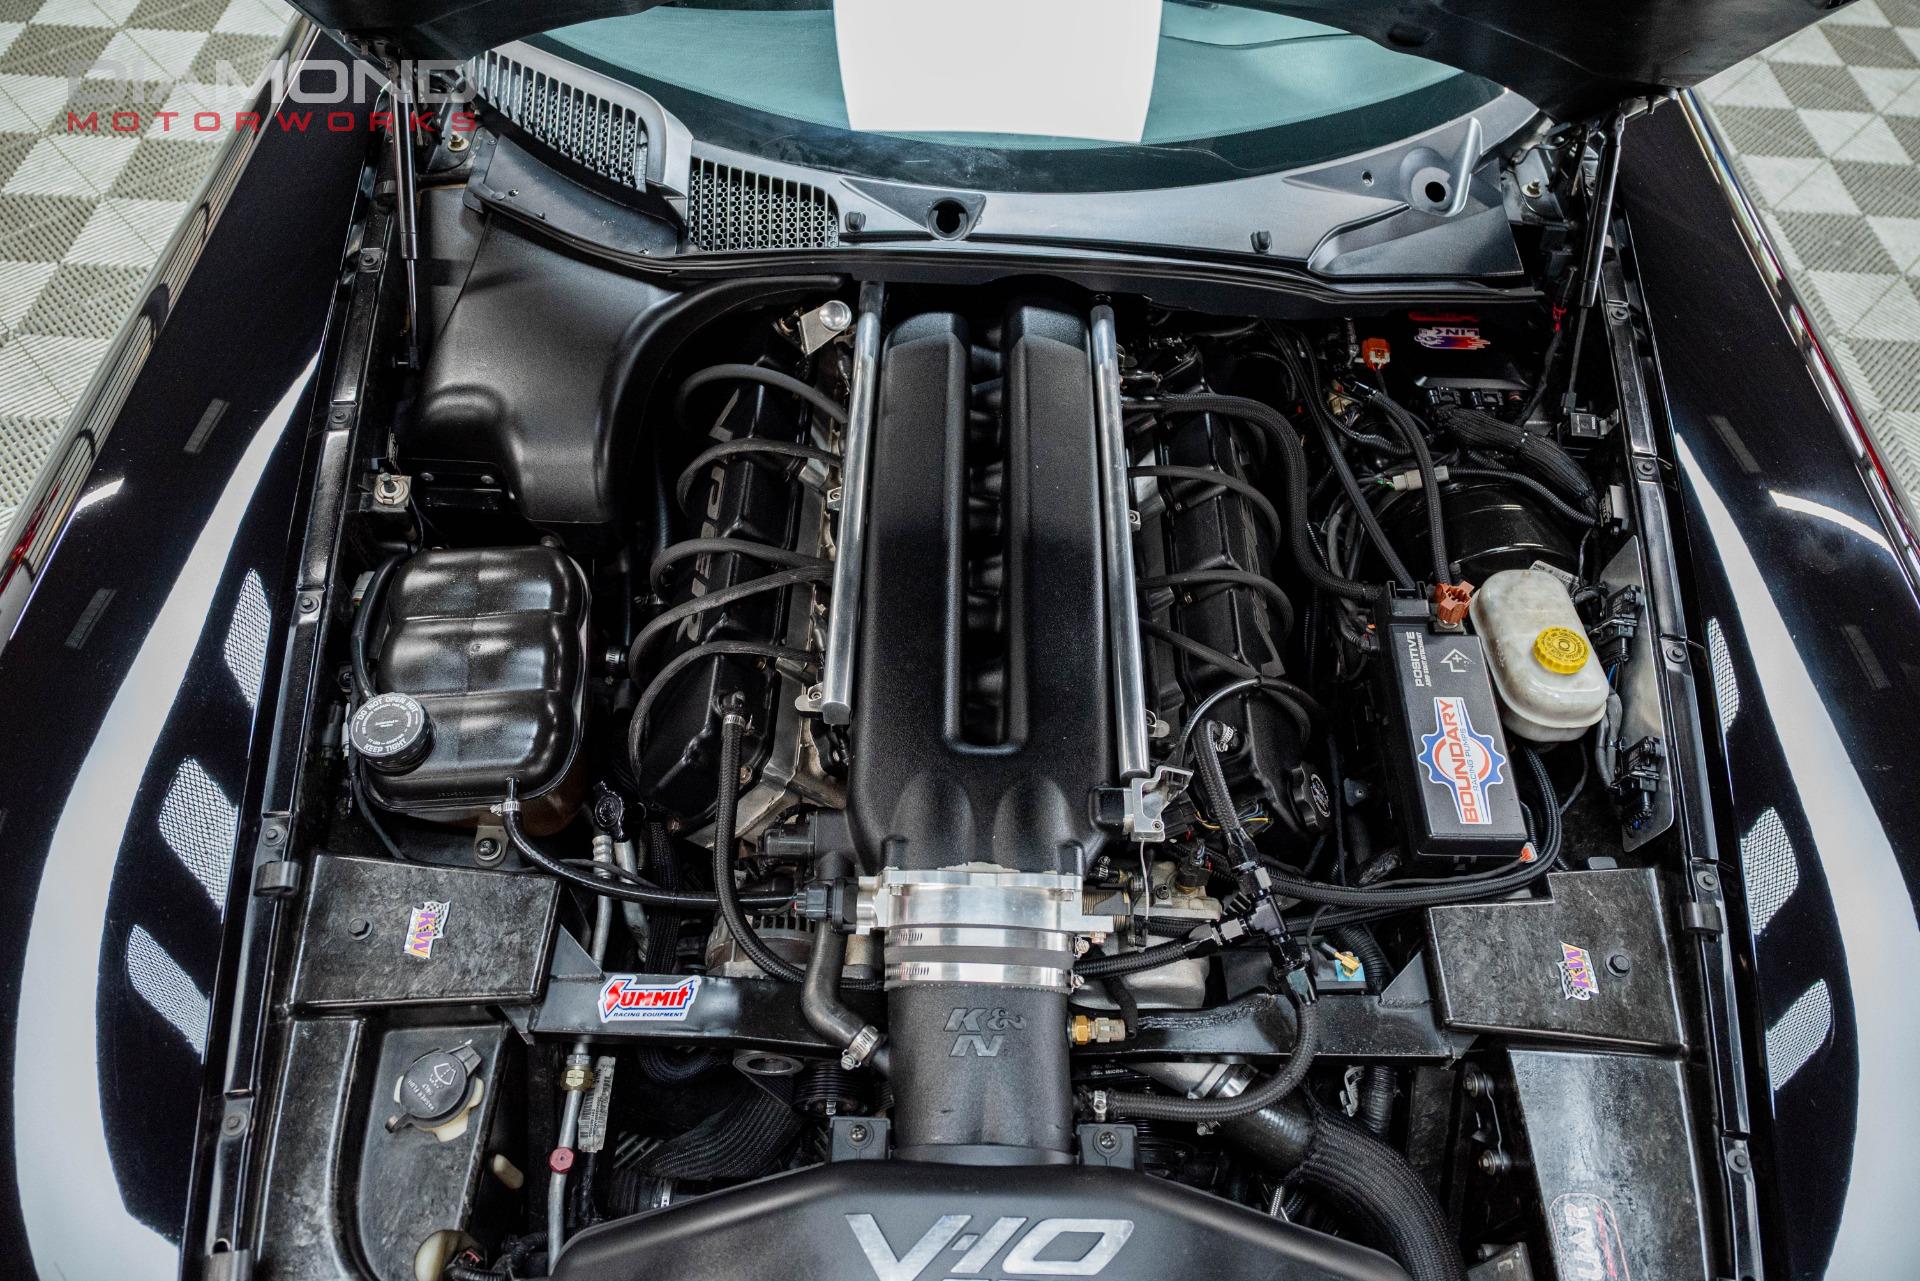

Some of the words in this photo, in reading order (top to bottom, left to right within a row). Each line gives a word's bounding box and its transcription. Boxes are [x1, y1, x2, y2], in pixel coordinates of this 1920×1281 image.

[1405, 631, 1425, 687] POSITIVE
[356, 710, 368, 721] DO
[366, 698, 383, 710] NOT
[385, 696, 407, 704] OPEN
[405, 701, 419, 713] HOT
[363, 743, 383, 753] KEEP
[385, 738, 407, 752] TIGHT
[1459, 728, 1471, 757] PUMPS
[1439, 699, 1480, 823] BOUNDARY
[1467, 759, 1479, 791] RACING
[845, 1213, 1135, 1281] V-10
